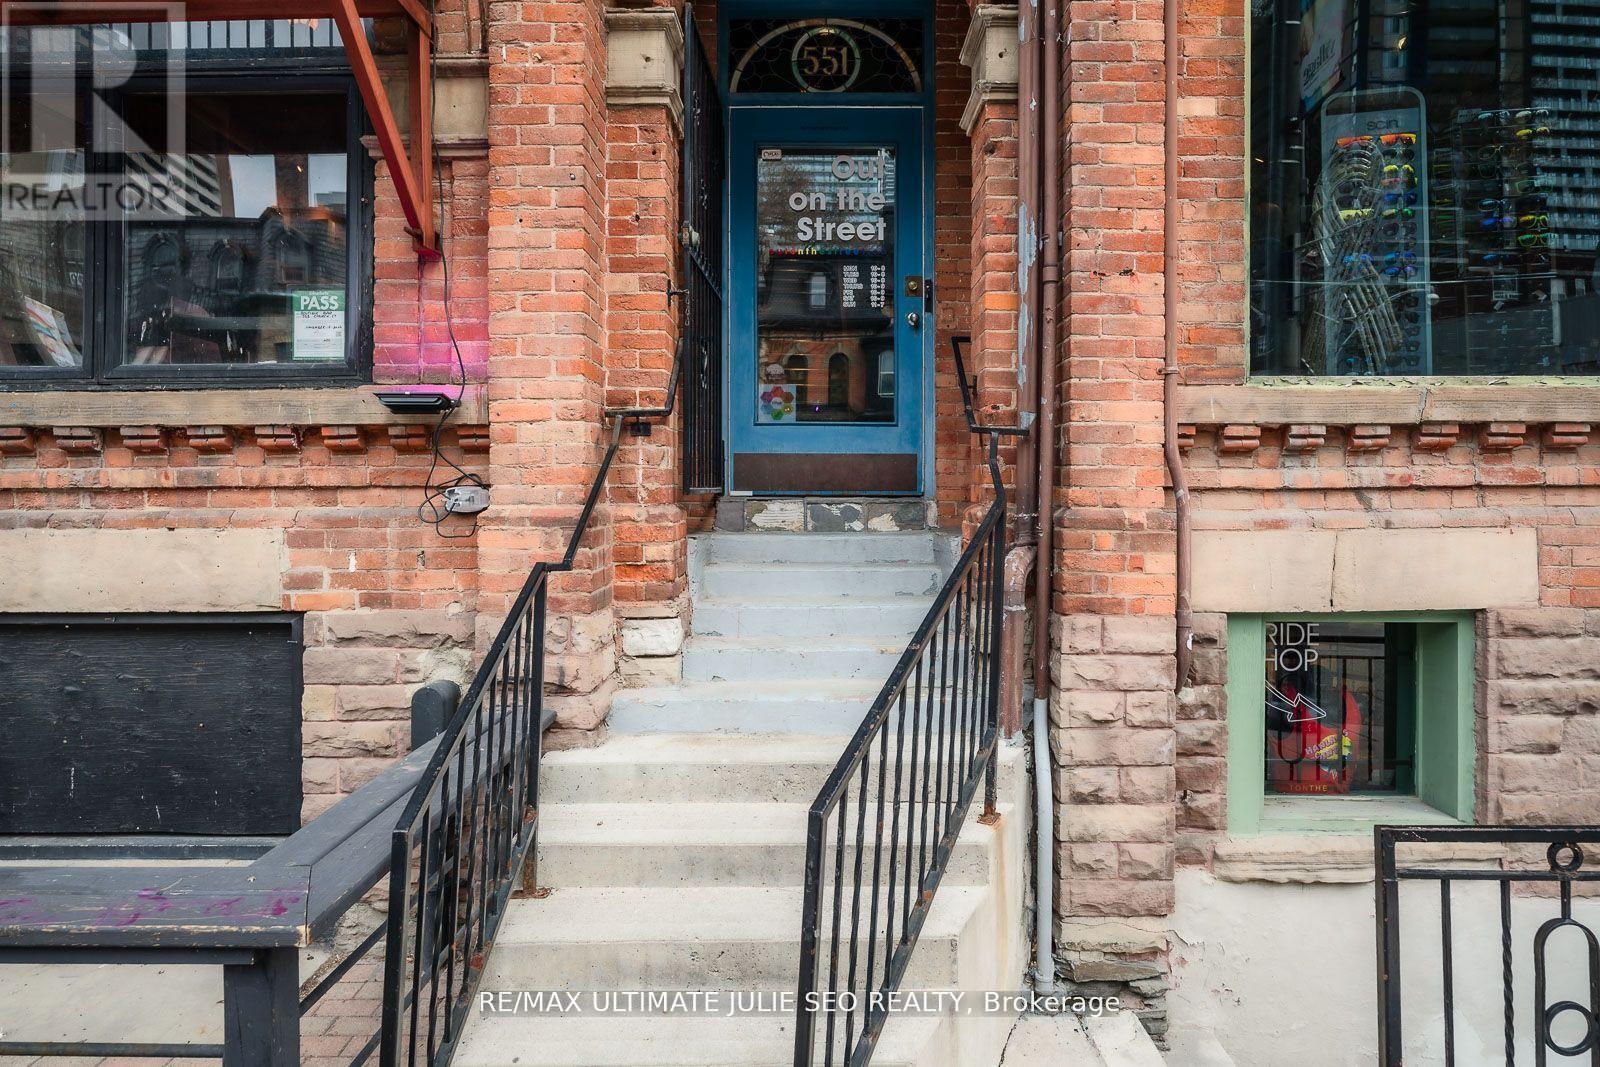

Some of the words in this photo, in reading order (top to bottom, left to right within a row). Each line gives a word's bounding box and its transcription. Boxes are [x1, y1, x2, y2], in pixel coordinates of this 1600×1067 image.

[803, 47, 848, 76] 551
[832, 155, 886, 181] Out
[789, 192, 826, 211] on
[837, 187, 886, 212] the
[797, 217, 887, 241] Street
[300, 295, 339, 311] PASS
[1265, 623, 1320, 646] RIDE
